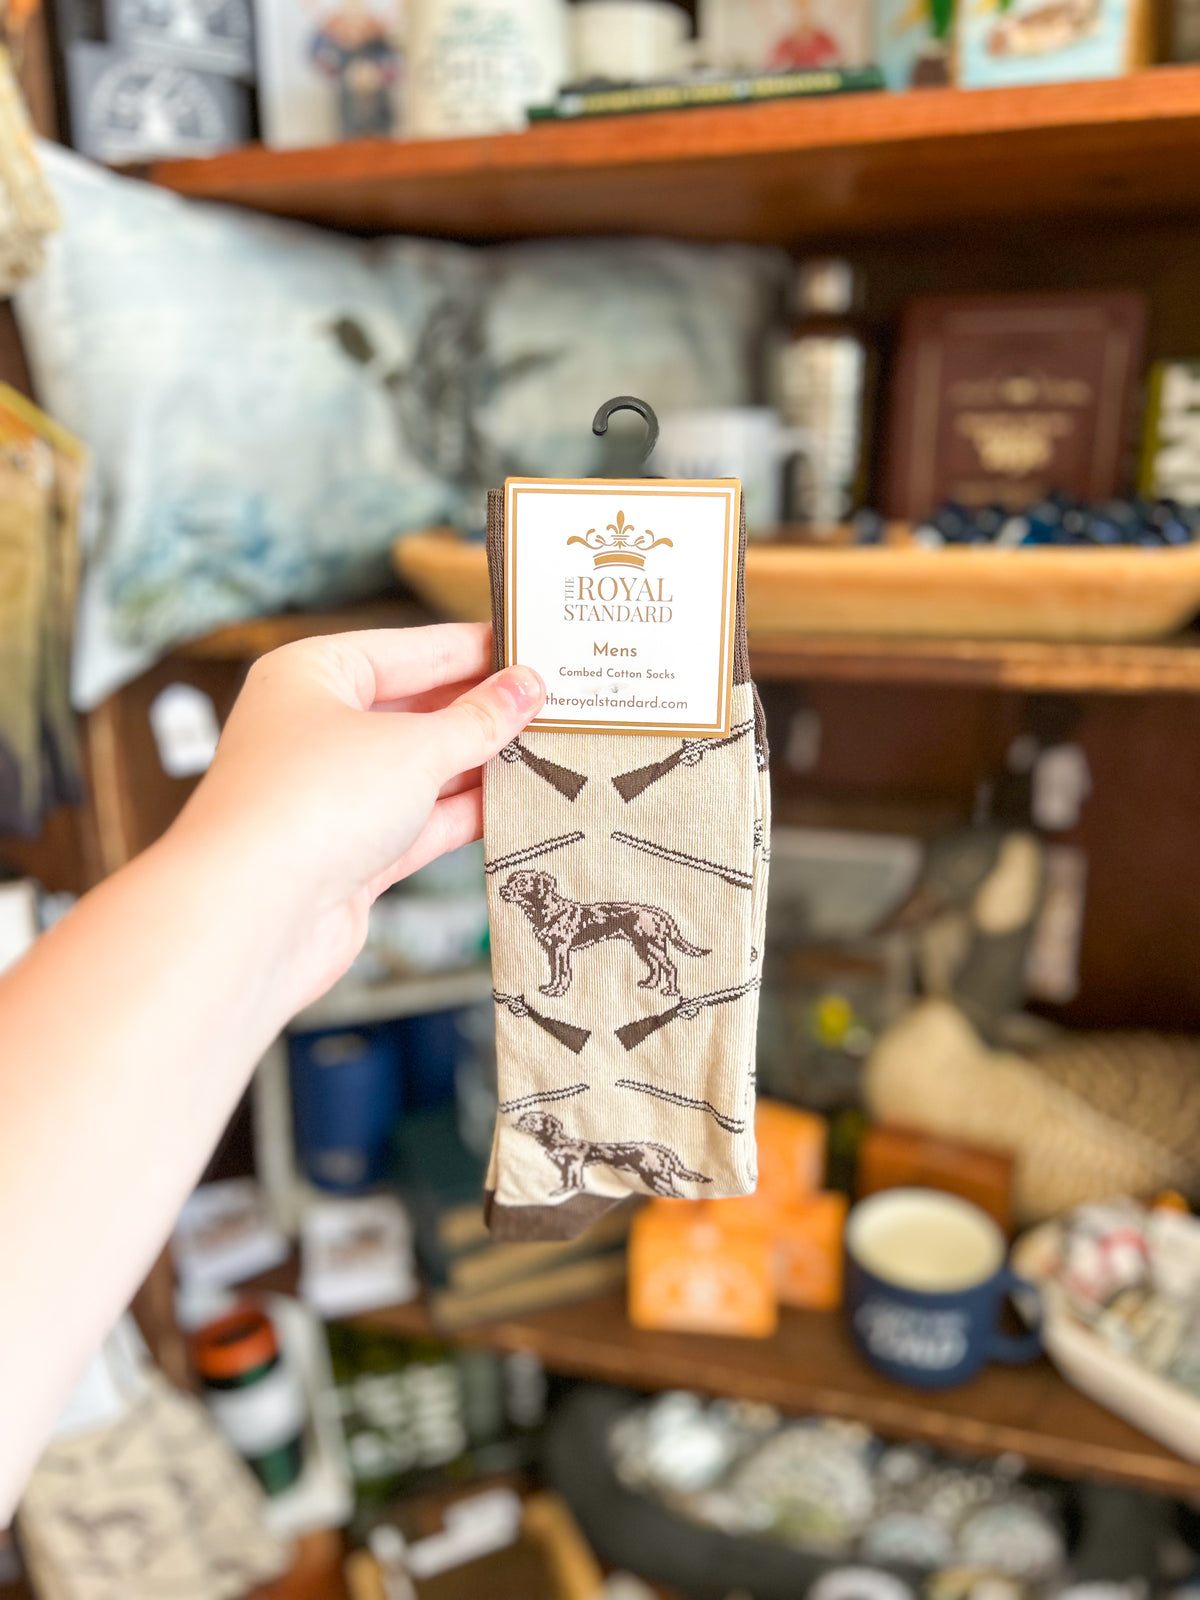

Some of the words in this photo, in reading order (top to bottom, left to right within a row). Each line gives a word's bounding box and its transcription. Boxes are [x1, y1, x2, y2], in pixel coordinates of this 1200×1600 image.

[565, 577, 574, 601] THE
[577, 576, 673, 602] ROYAL
[564, 604, 673, 623] STANDARD
[593, 642, 637, 657] Mens
[559, 667, 602, 678] Combed
[606, 668, 642, 679] Cotton
[646, 669, 675, 680] Socks
[545, 692, 688, 709] theroyalstandard.com
